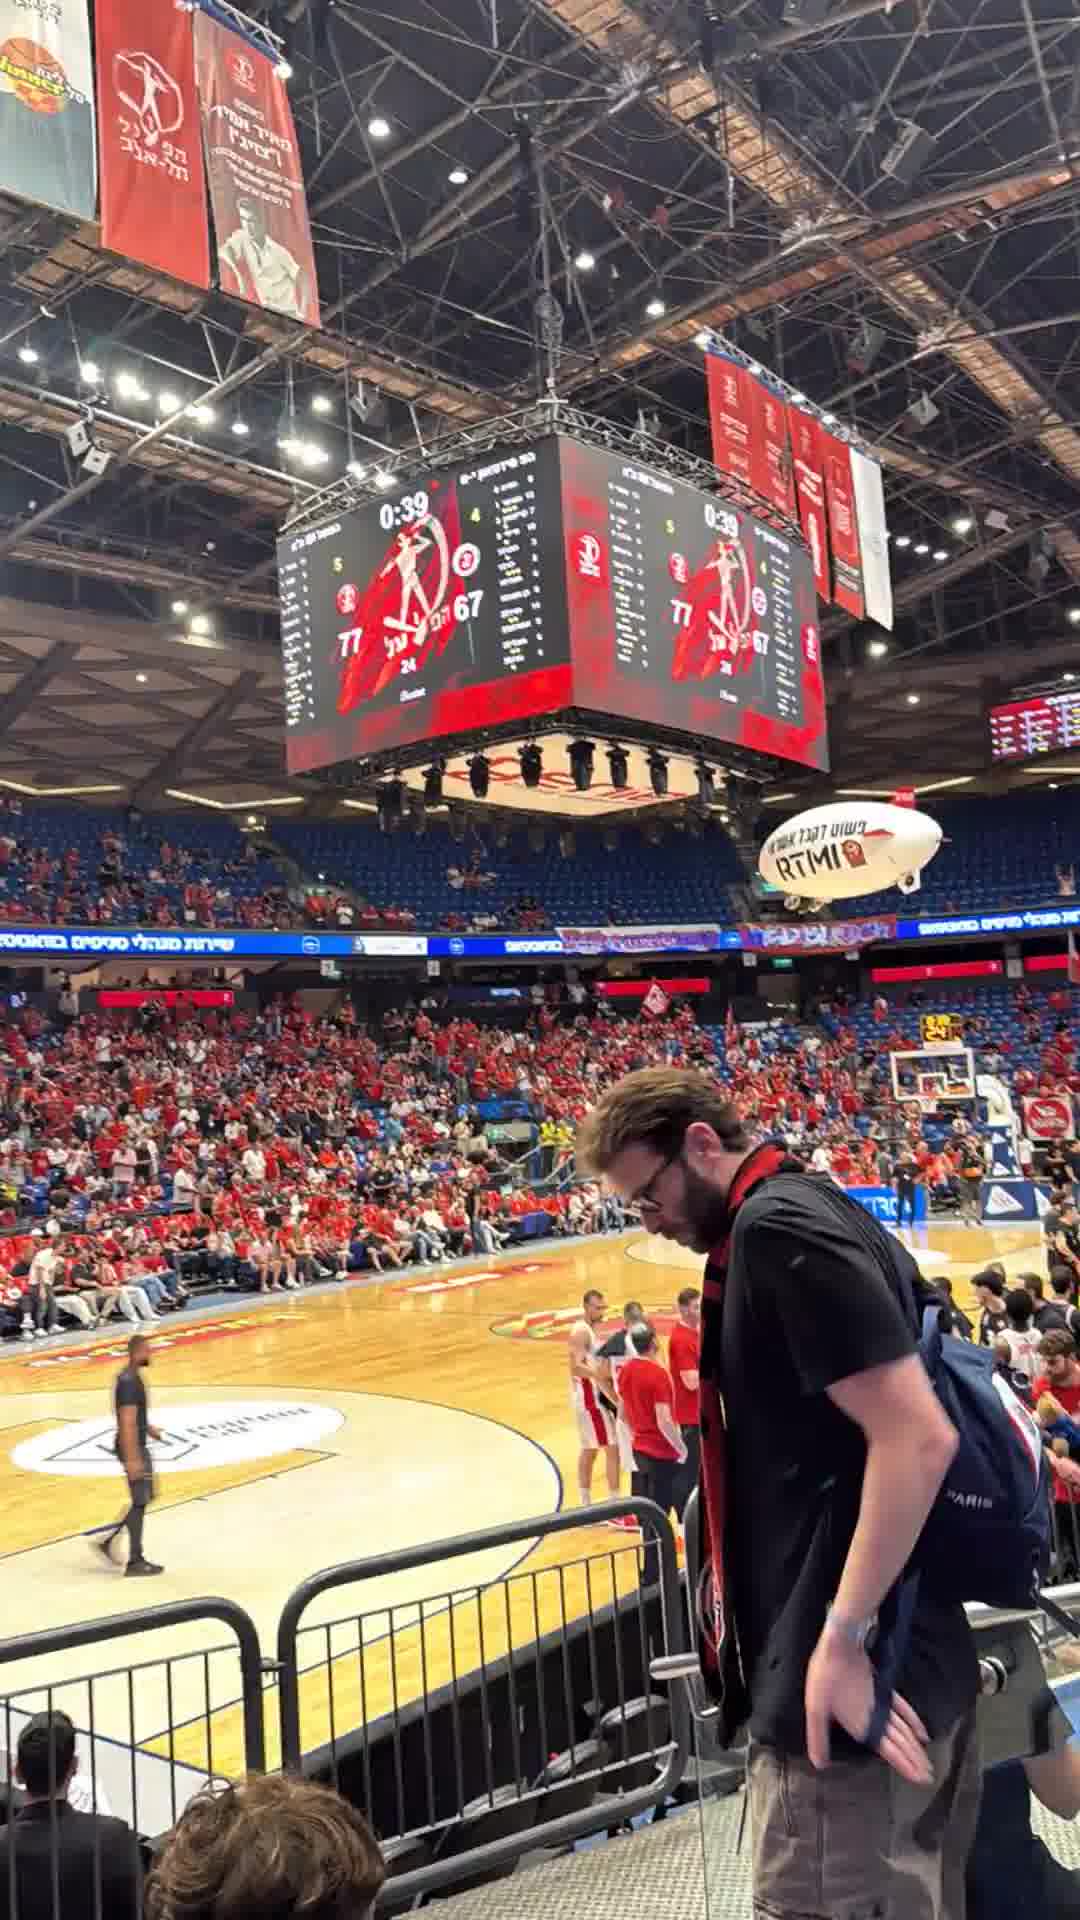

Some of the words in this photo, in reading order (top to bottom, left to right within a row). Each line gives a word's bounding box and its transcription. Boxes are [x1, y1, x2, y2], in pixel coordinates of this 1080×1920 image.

[380, 491, 429, 529] 0:39
[453, 590, 483, 621] 67
[671, 600, 692, 627] 77
[337, 628, 363, 657] 77
[831, 820, 868, 838] פשוט
[776, 843, 841, 881] RTMI
